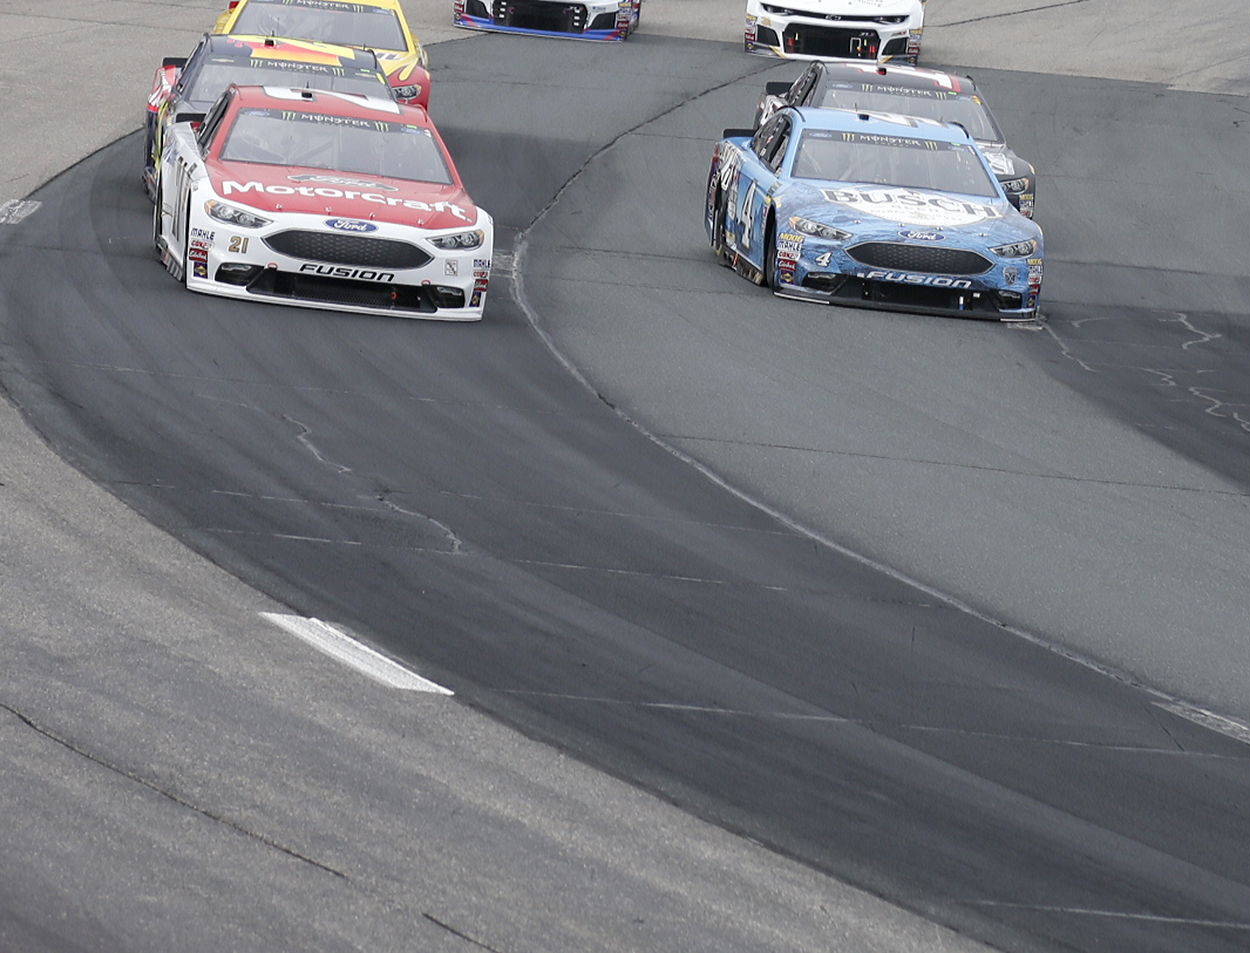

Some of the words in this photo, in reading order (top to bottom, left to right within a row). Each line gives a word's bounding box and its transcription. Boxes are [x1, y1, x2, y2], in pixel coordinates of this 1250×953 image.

[296, 0, 350, 10] MONSTER
[266, 60, 330, 73] MONSTER
[876, 86, 932, 97] MONSTER
[301, 113, 370, 128] MONSTER
[859, 135, 921, 147] MONSTER
[222, 180, 467, 221] Motorcraft
[824, 190, 998, 218] BUSCH
[740, 179, 758, 249] 4
[334, 219, 367, 232] Ford
[191, 228, 215, 240] MAHLE
[908, 230, 937, 240] Ford
[229, 236, 249, 254] 21
[815, 252, 832, 267] 4
[299, 264, 395, 282] FUSION
[867, 270, 972, 289] FUSION
